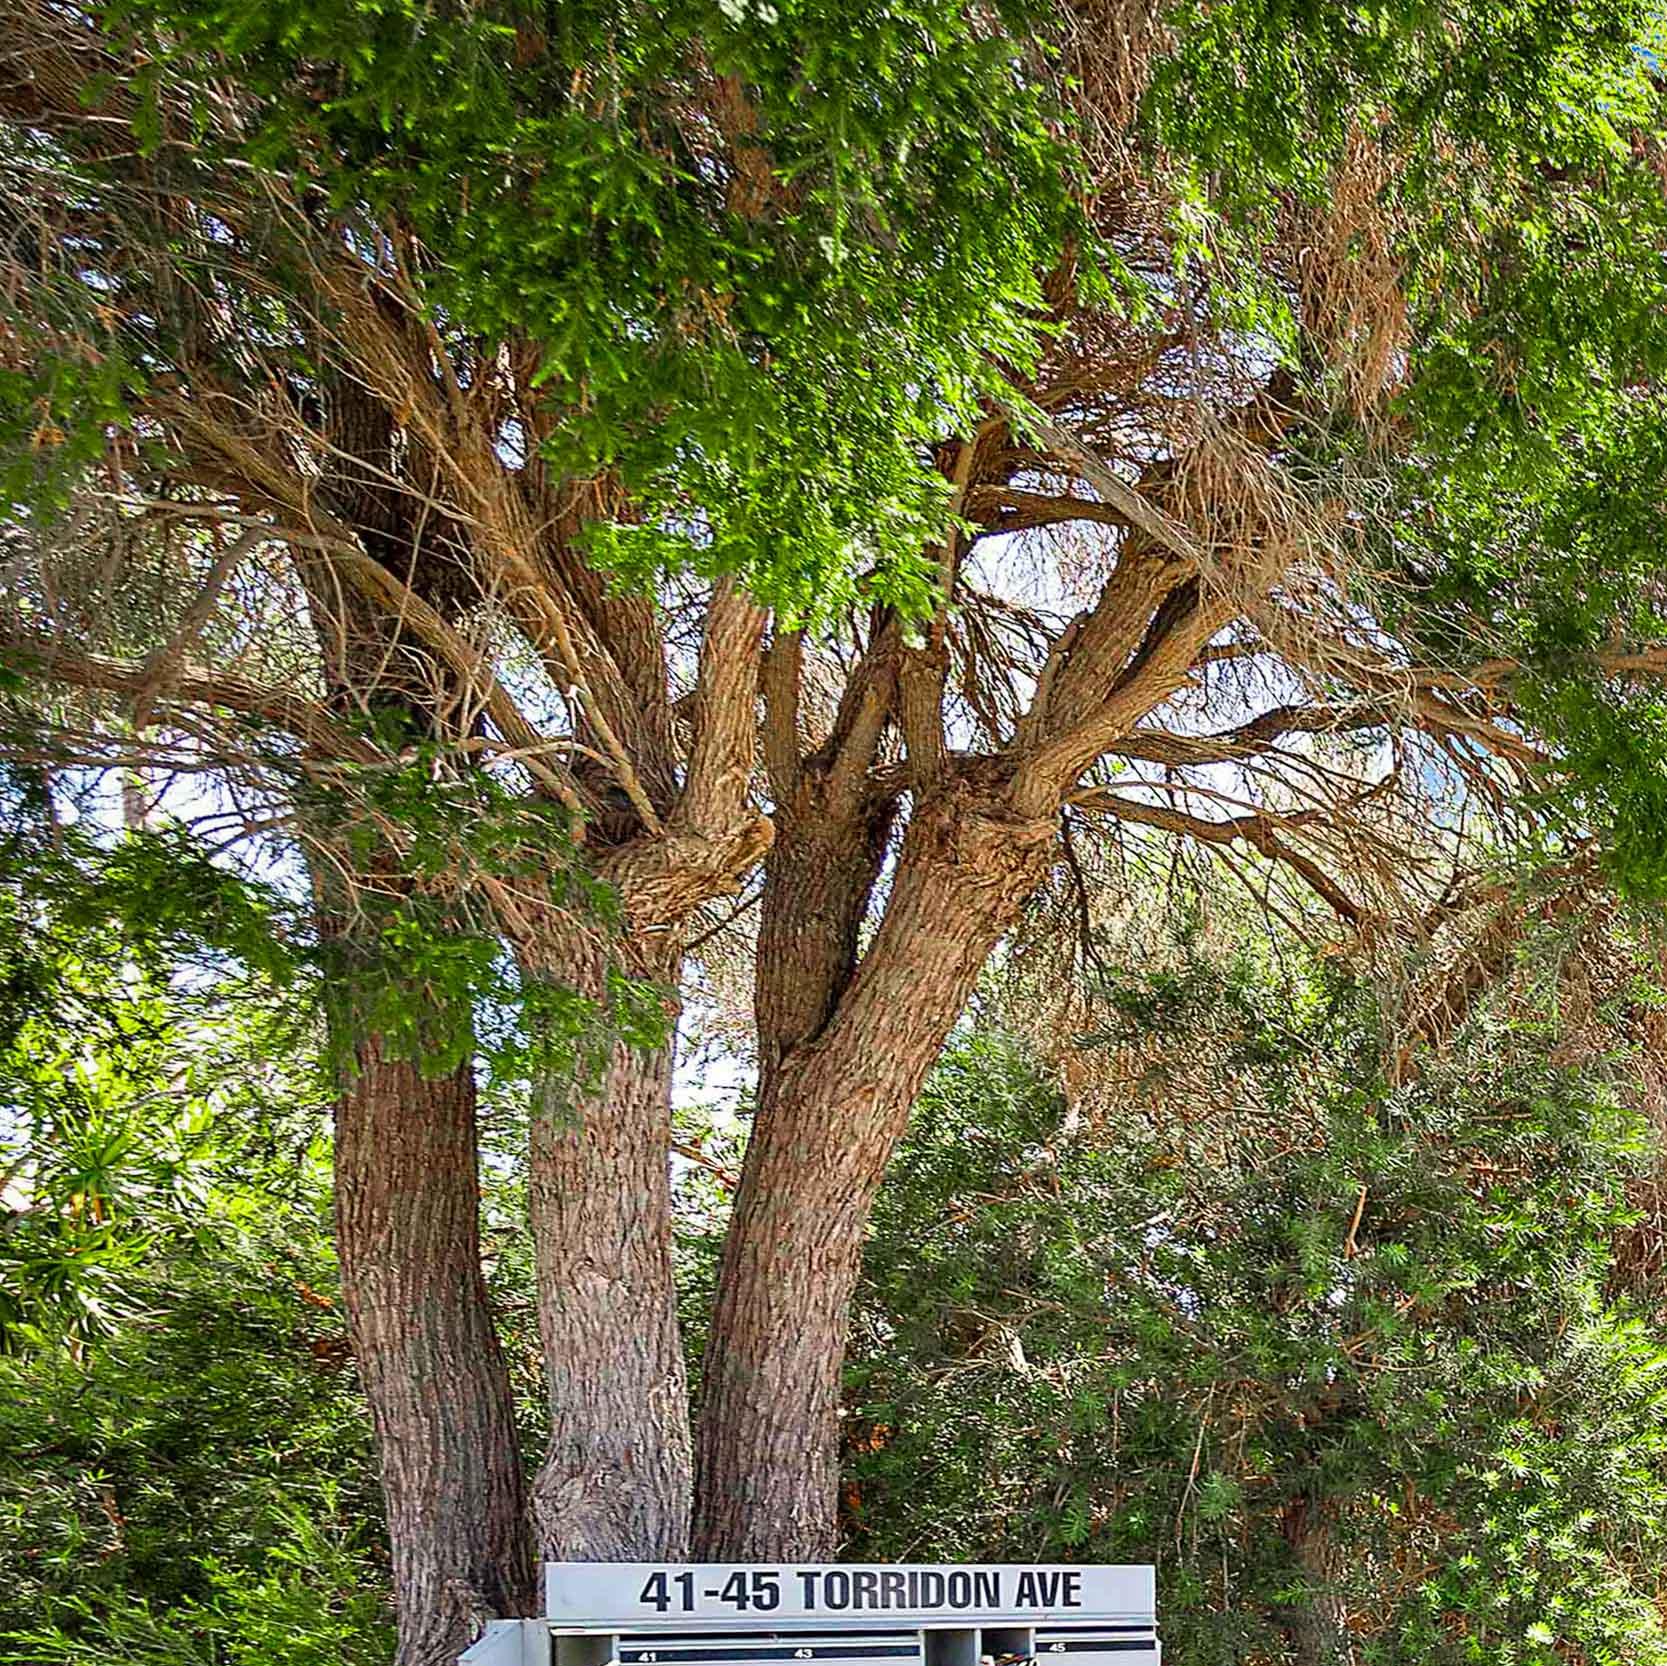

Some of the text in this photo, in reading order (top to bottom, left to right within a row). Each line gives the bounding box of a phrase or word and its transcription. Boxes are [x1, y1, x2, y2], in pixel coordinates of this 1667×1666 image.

[640, 1571, 1081, 1611] 41-45 TORRIDON AVE
[1050, 1643, 1066, 1652] 45
[638, 1652, 656, 1662] 41
[794, 1649, 813, 1658] 43
